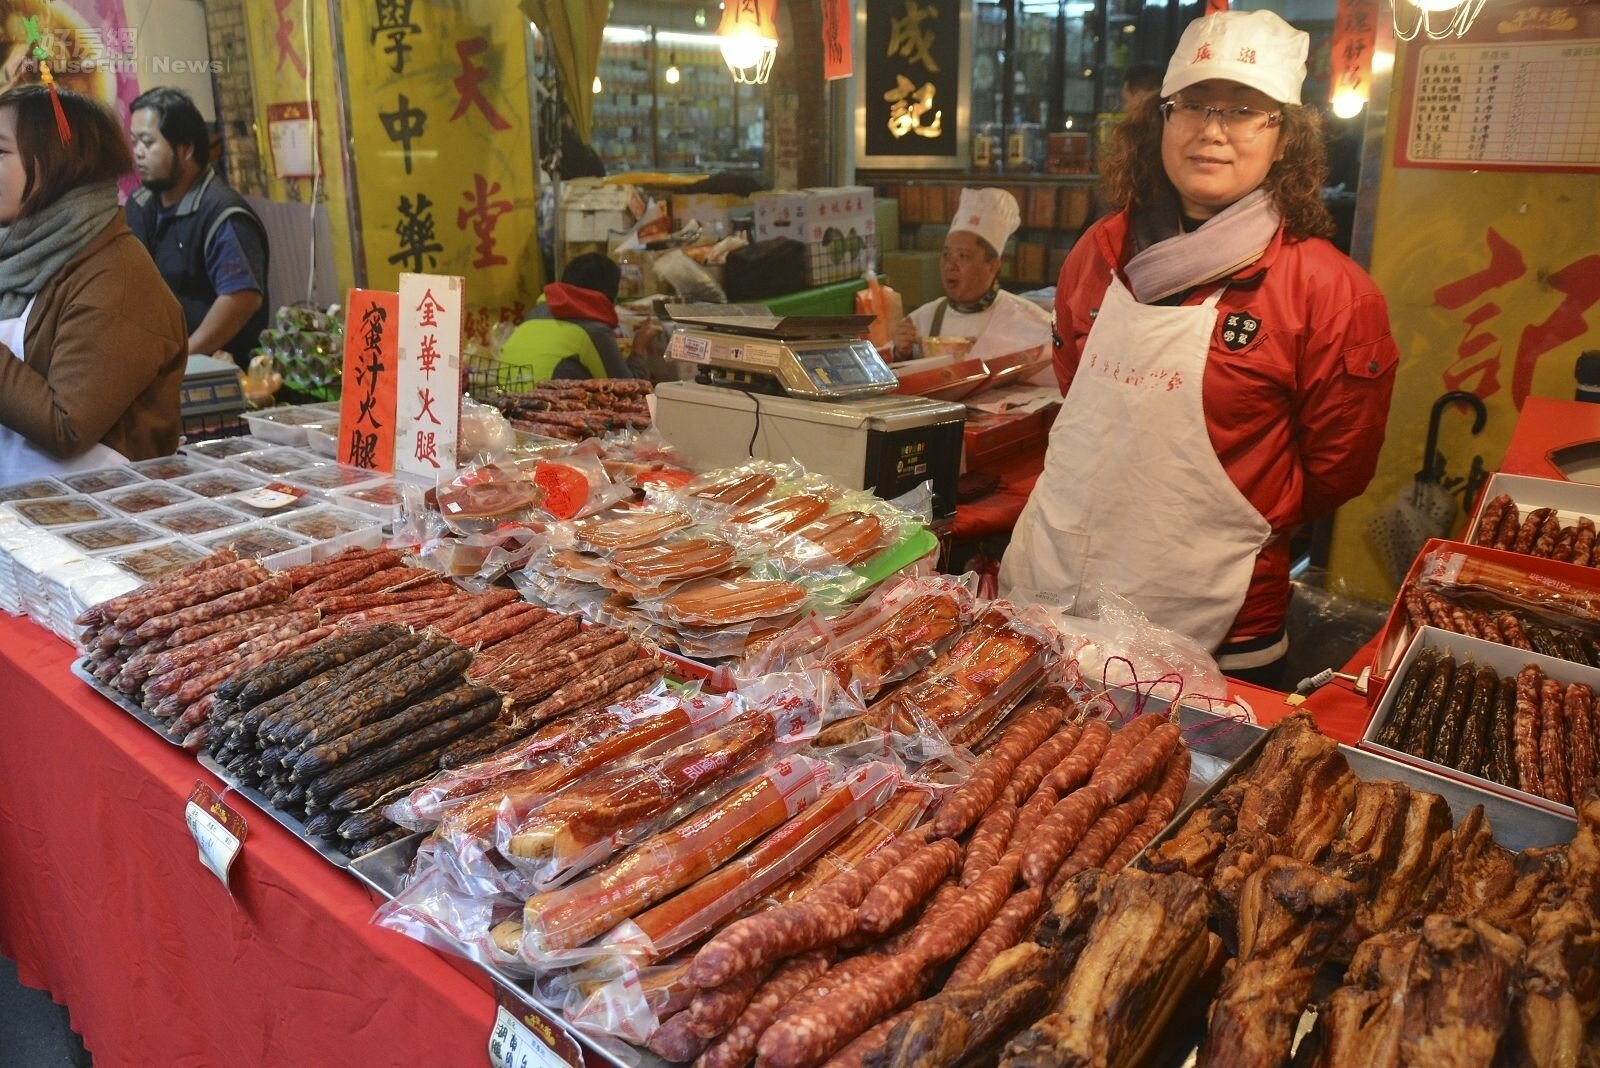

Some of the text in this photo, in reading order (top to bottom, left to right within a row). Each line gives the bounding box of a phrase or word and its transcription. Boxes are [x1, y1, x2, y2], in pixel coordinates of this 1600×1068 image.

[451, 36, 514, 271] 天堂
[347, 300, 388, 469] 蜜汁火腿
[413, 287, 446, 469] 金華火腿
